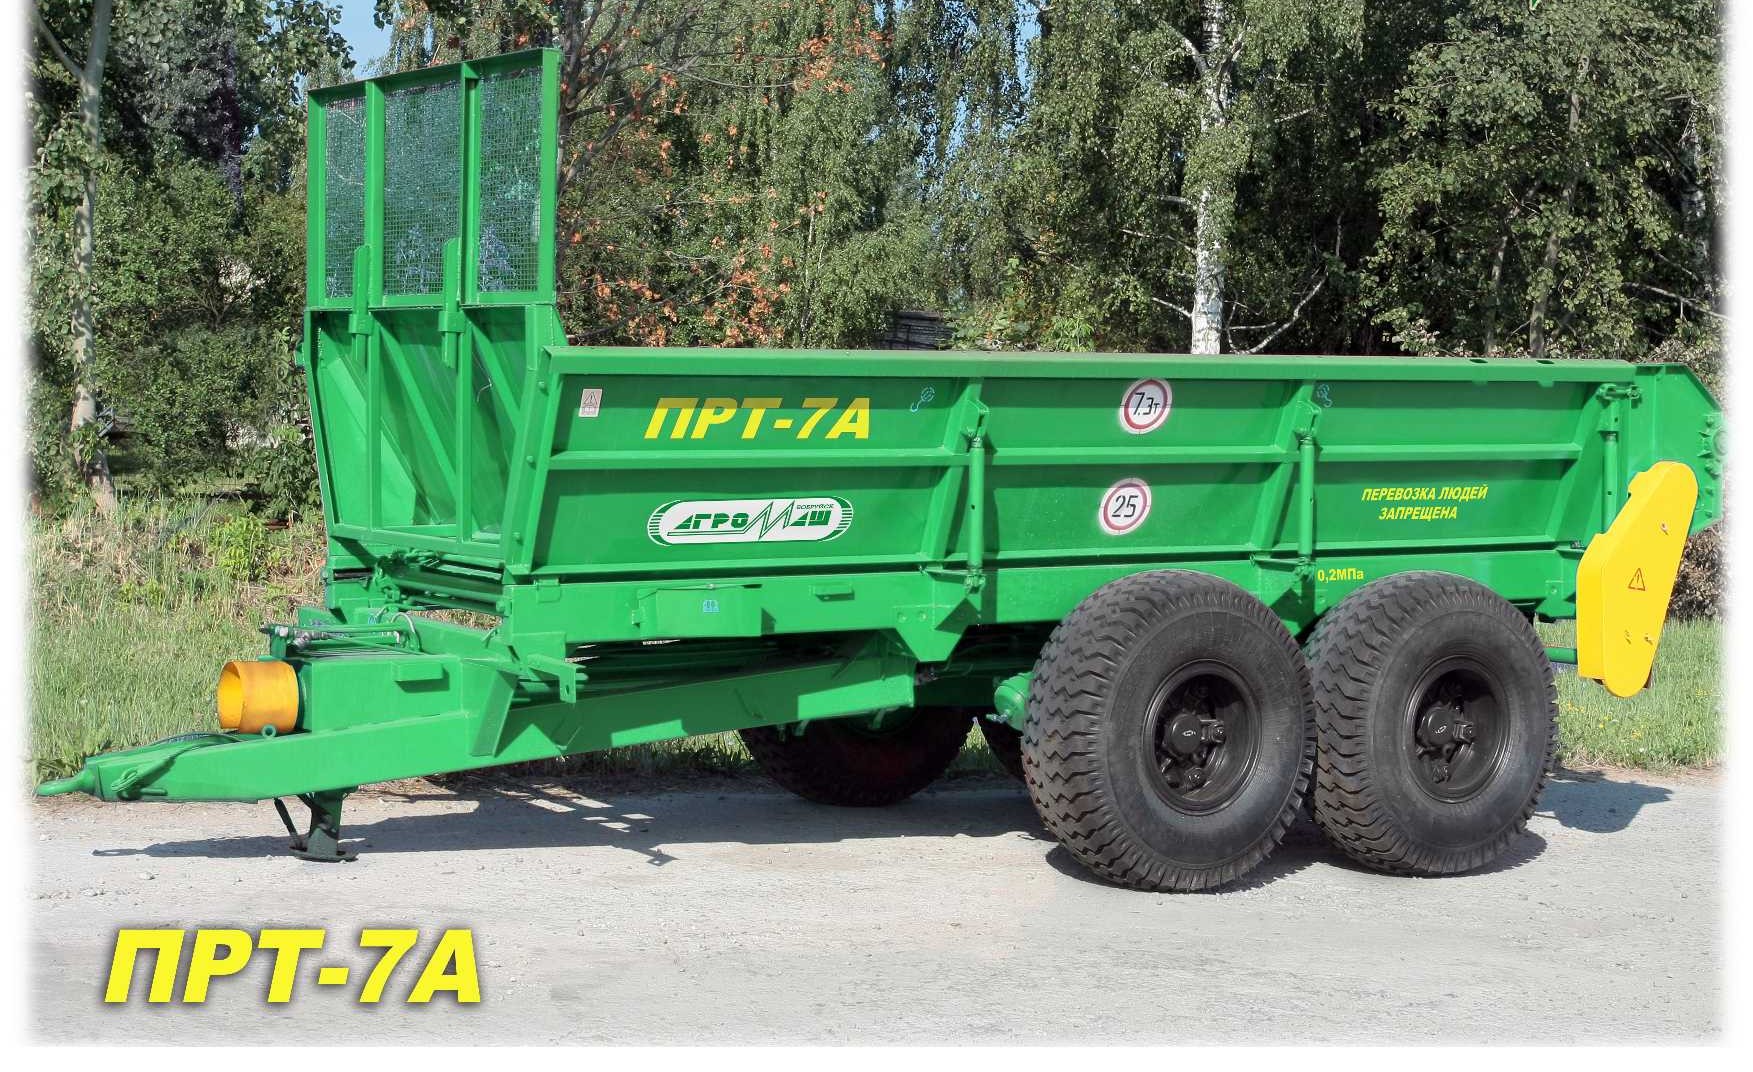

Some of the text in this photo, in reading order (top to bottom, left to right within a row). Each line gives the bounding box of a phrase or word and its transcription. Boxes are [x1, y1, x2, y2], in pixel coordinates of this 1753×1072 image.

[644, 397, 870, 440] ПРТ-7А
[1361, 483, 1489, 502] ПЕРЕВОЗКА ЛЮДЕЙ
[1111, 495, 1139, 518] 25
[1378, 506, 1458, 521] ЗАПРЕЩЕНА
[1317, 567, 1364, 584] 0,2МПа
